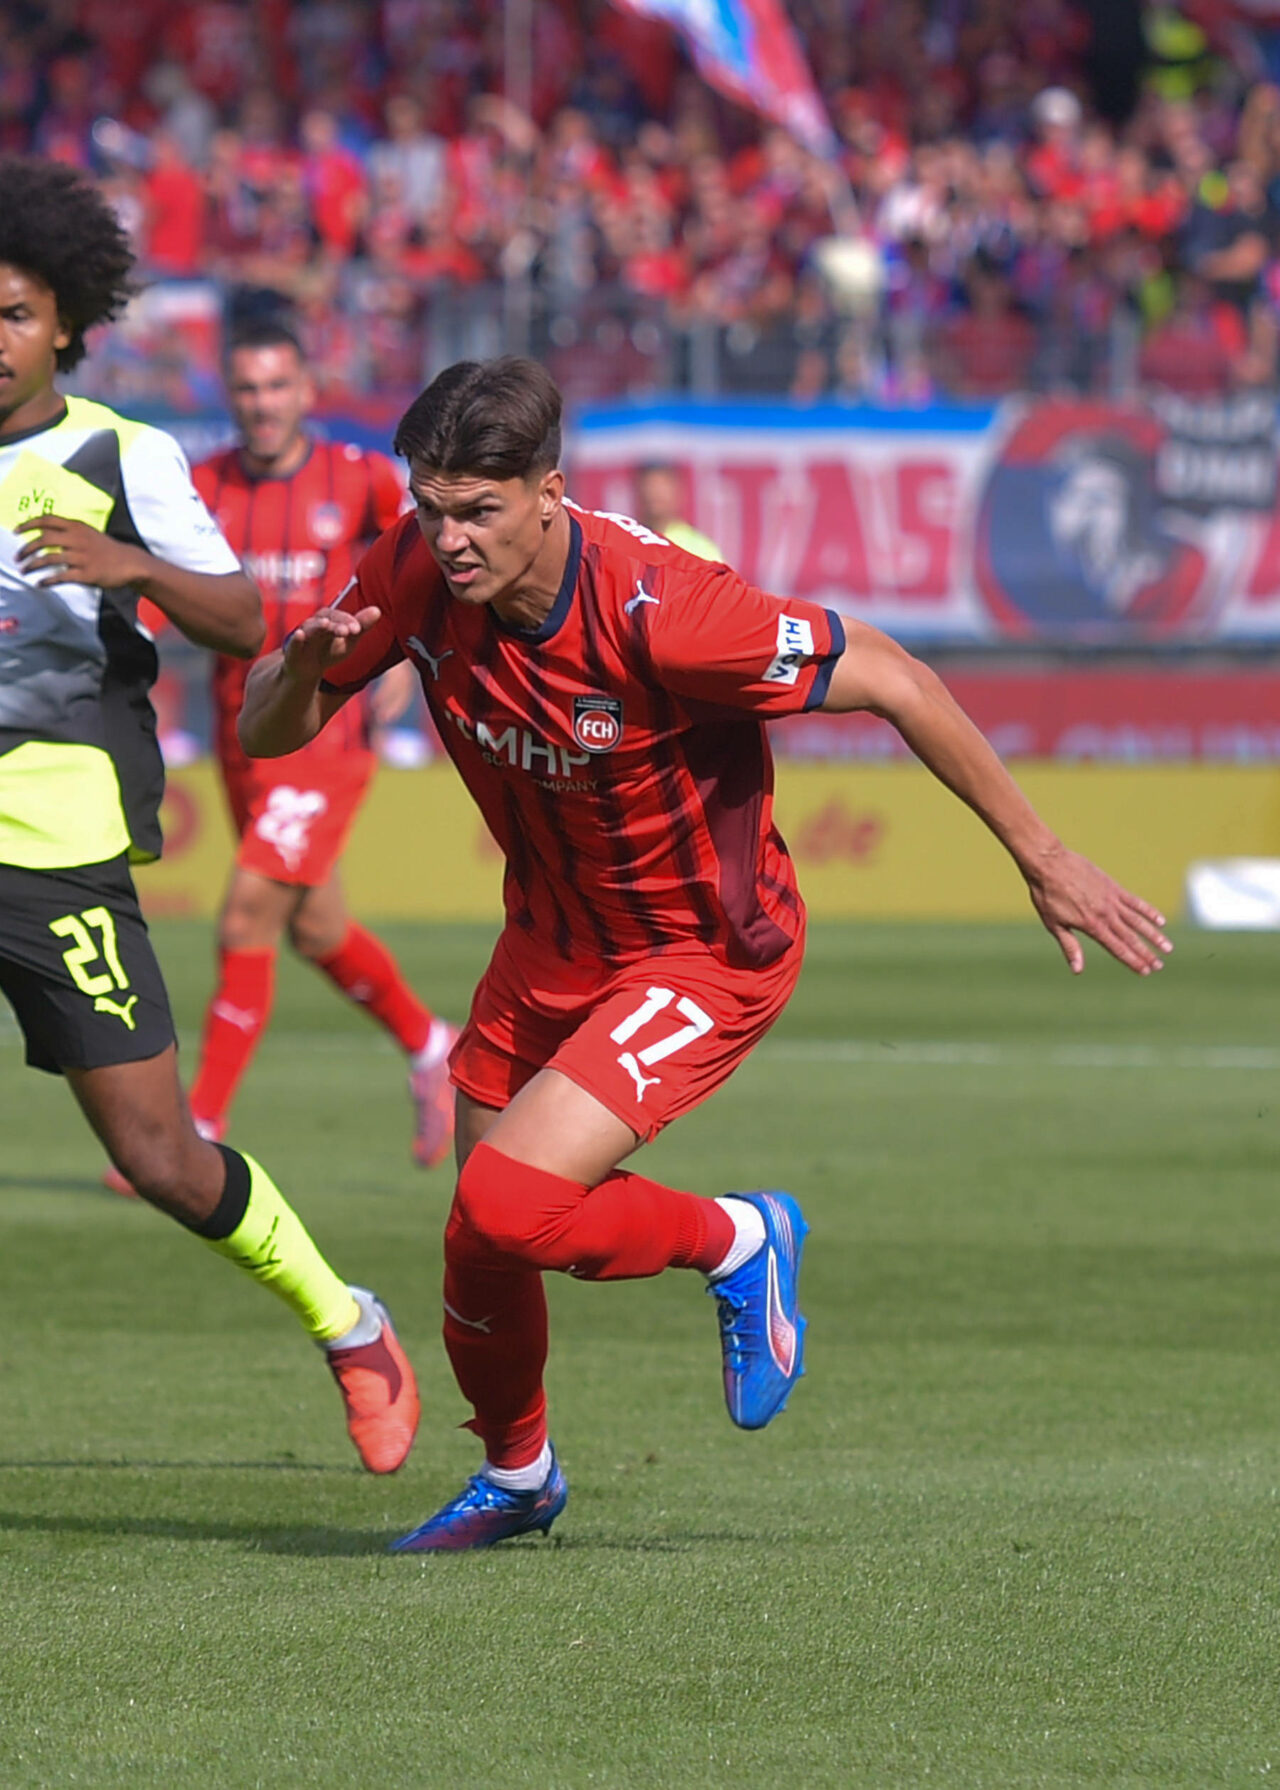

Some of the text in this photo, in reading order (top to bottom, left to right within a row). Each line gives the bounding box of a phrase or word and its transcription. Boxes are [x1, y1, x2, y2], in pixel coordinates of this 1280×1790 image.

[18, 487, 55, 515] BVB
[770, 620, 802, 679] VOITH
[476, 721, 591, 777] MHP
[582, 719, 613, 739] FCH
[48, 905, 131, 997] 27
[610, 986, 715, 1067] 17
